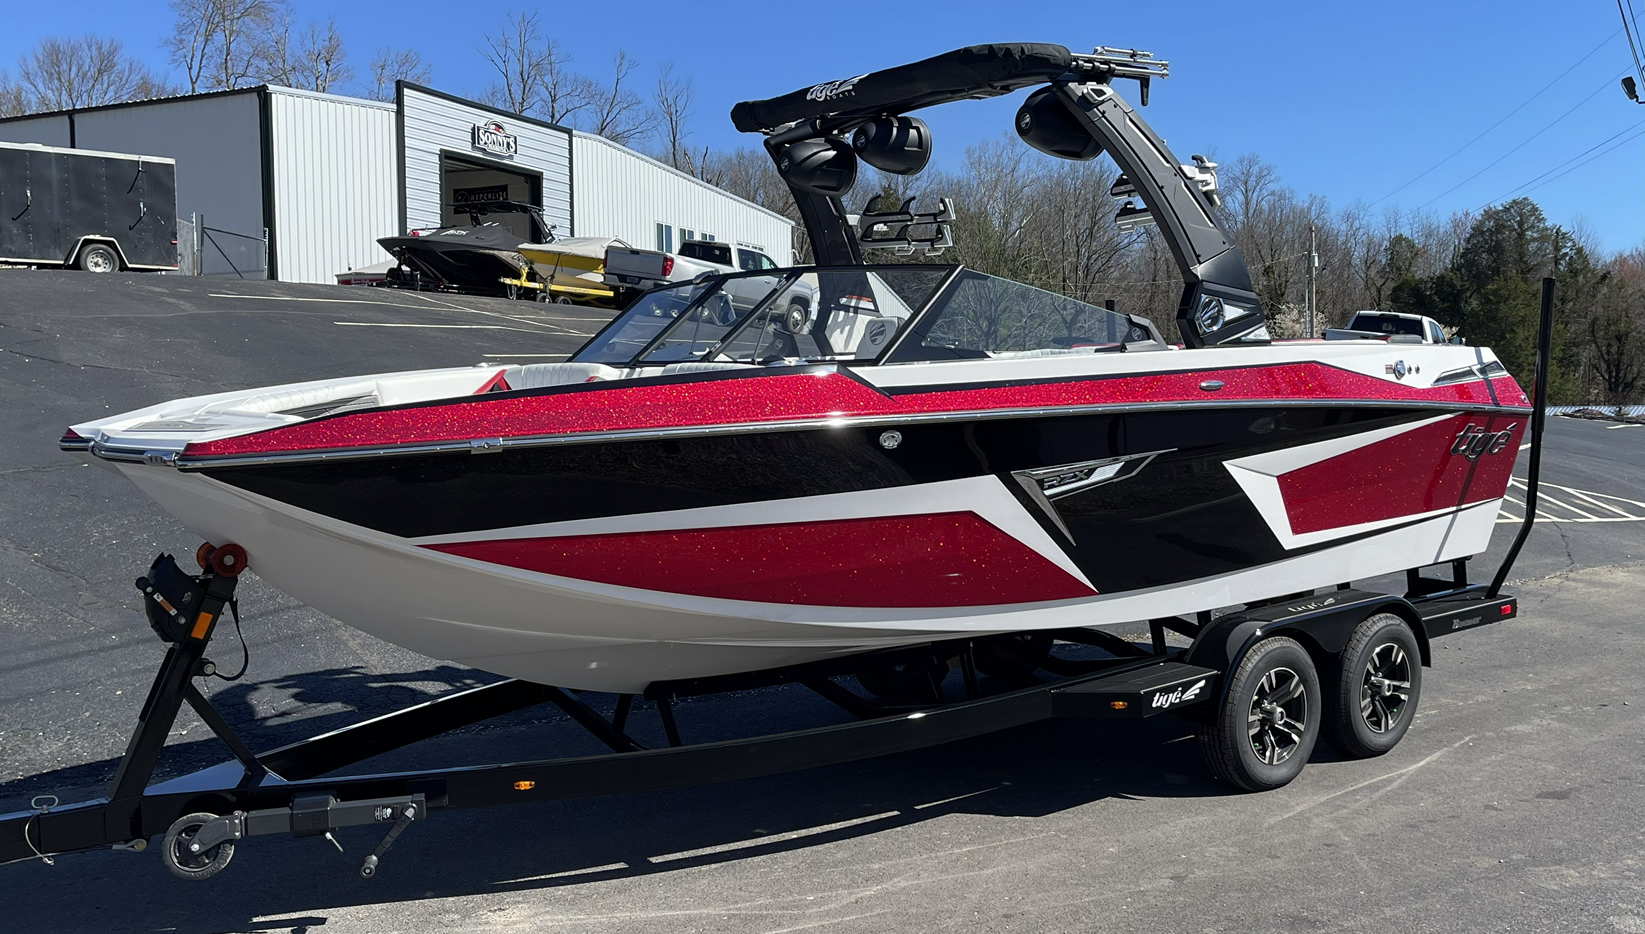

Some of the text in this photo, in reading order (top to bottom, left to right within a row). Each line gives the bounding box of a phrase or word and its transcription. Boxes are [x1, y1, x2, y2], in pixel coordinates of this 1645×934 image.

[479, 129, 516, 153] SONNY'S
[470, 191, 507, 201] HYPERLITE
[1043, 469, 1089, 489] RZX
